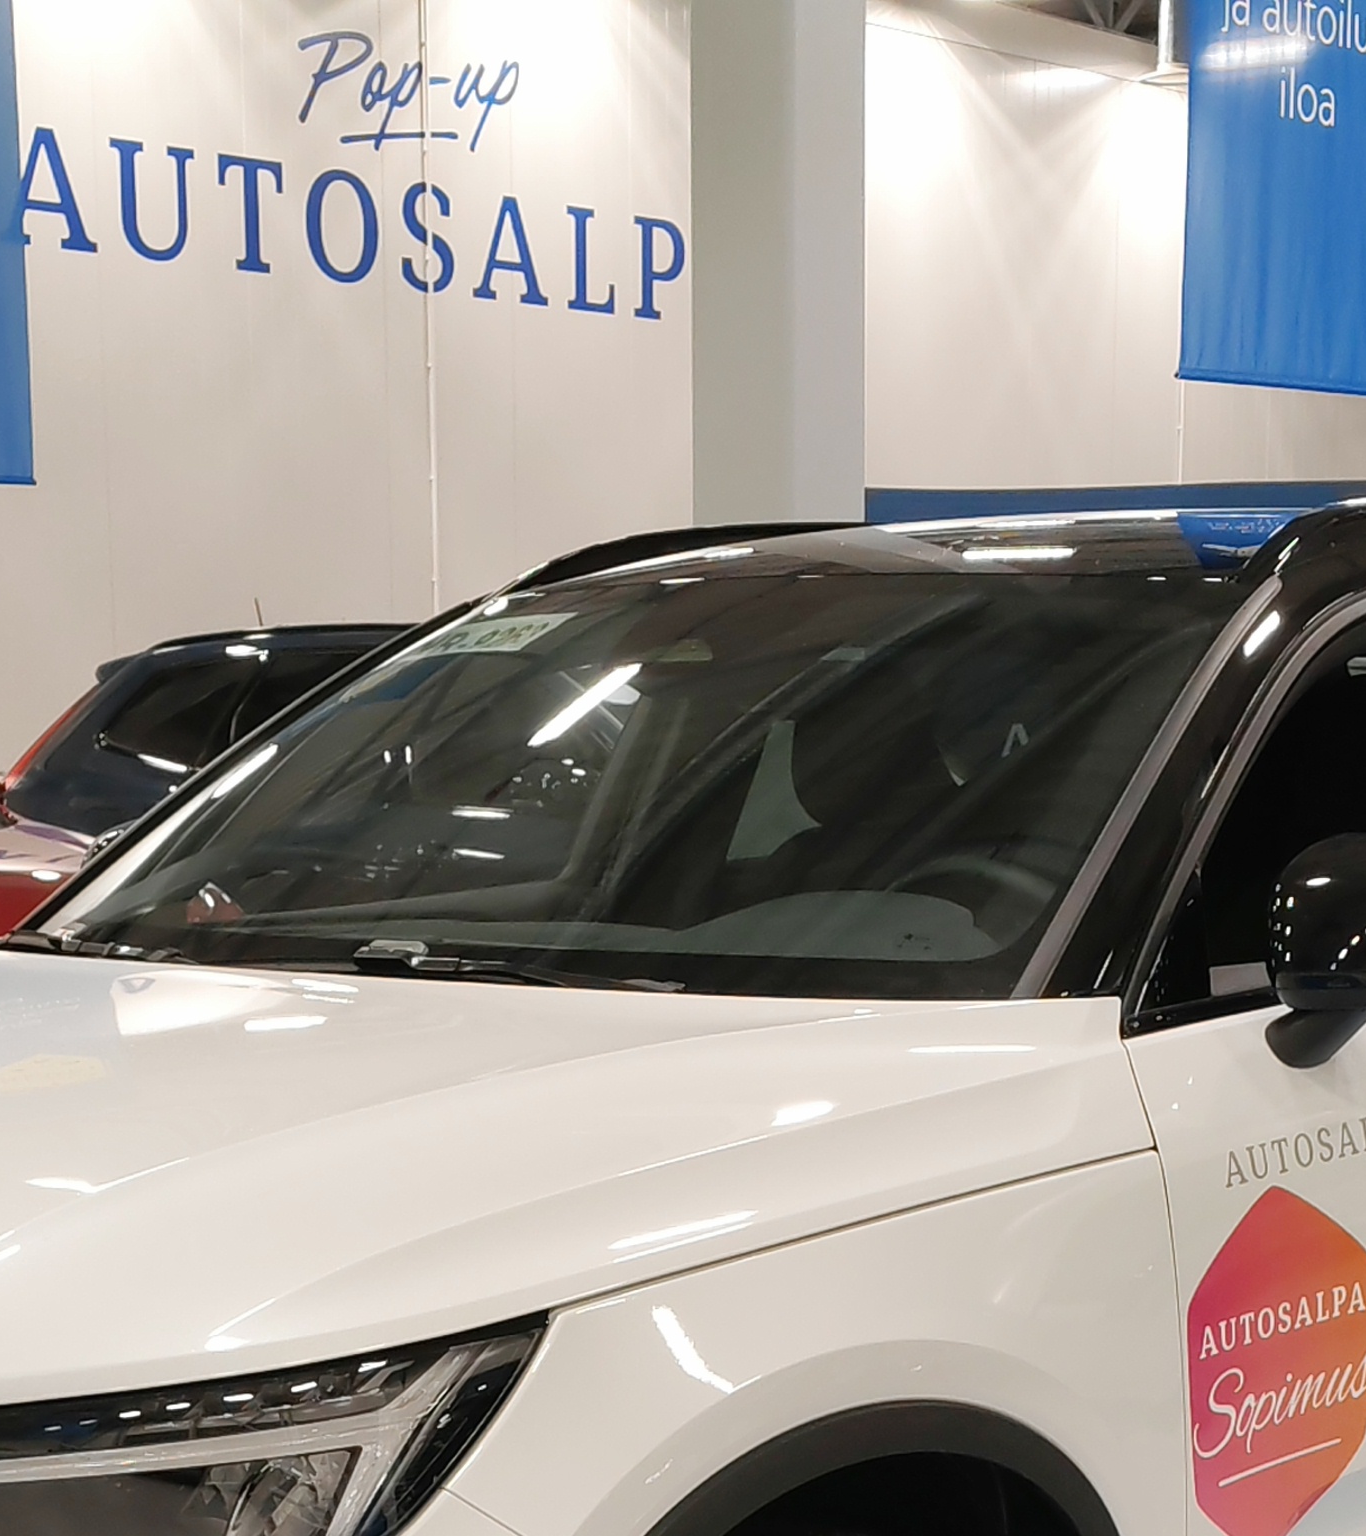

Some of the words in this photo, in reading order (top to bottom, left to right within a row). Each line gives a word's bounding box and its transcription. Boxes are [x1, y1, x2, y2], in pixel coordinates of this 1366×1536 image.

[297, 30, 520, 152] Pop-up
[1279, 66, 1335, 127] iloa
[1198, 1282, 1366, 1361] AUTOSALPA
